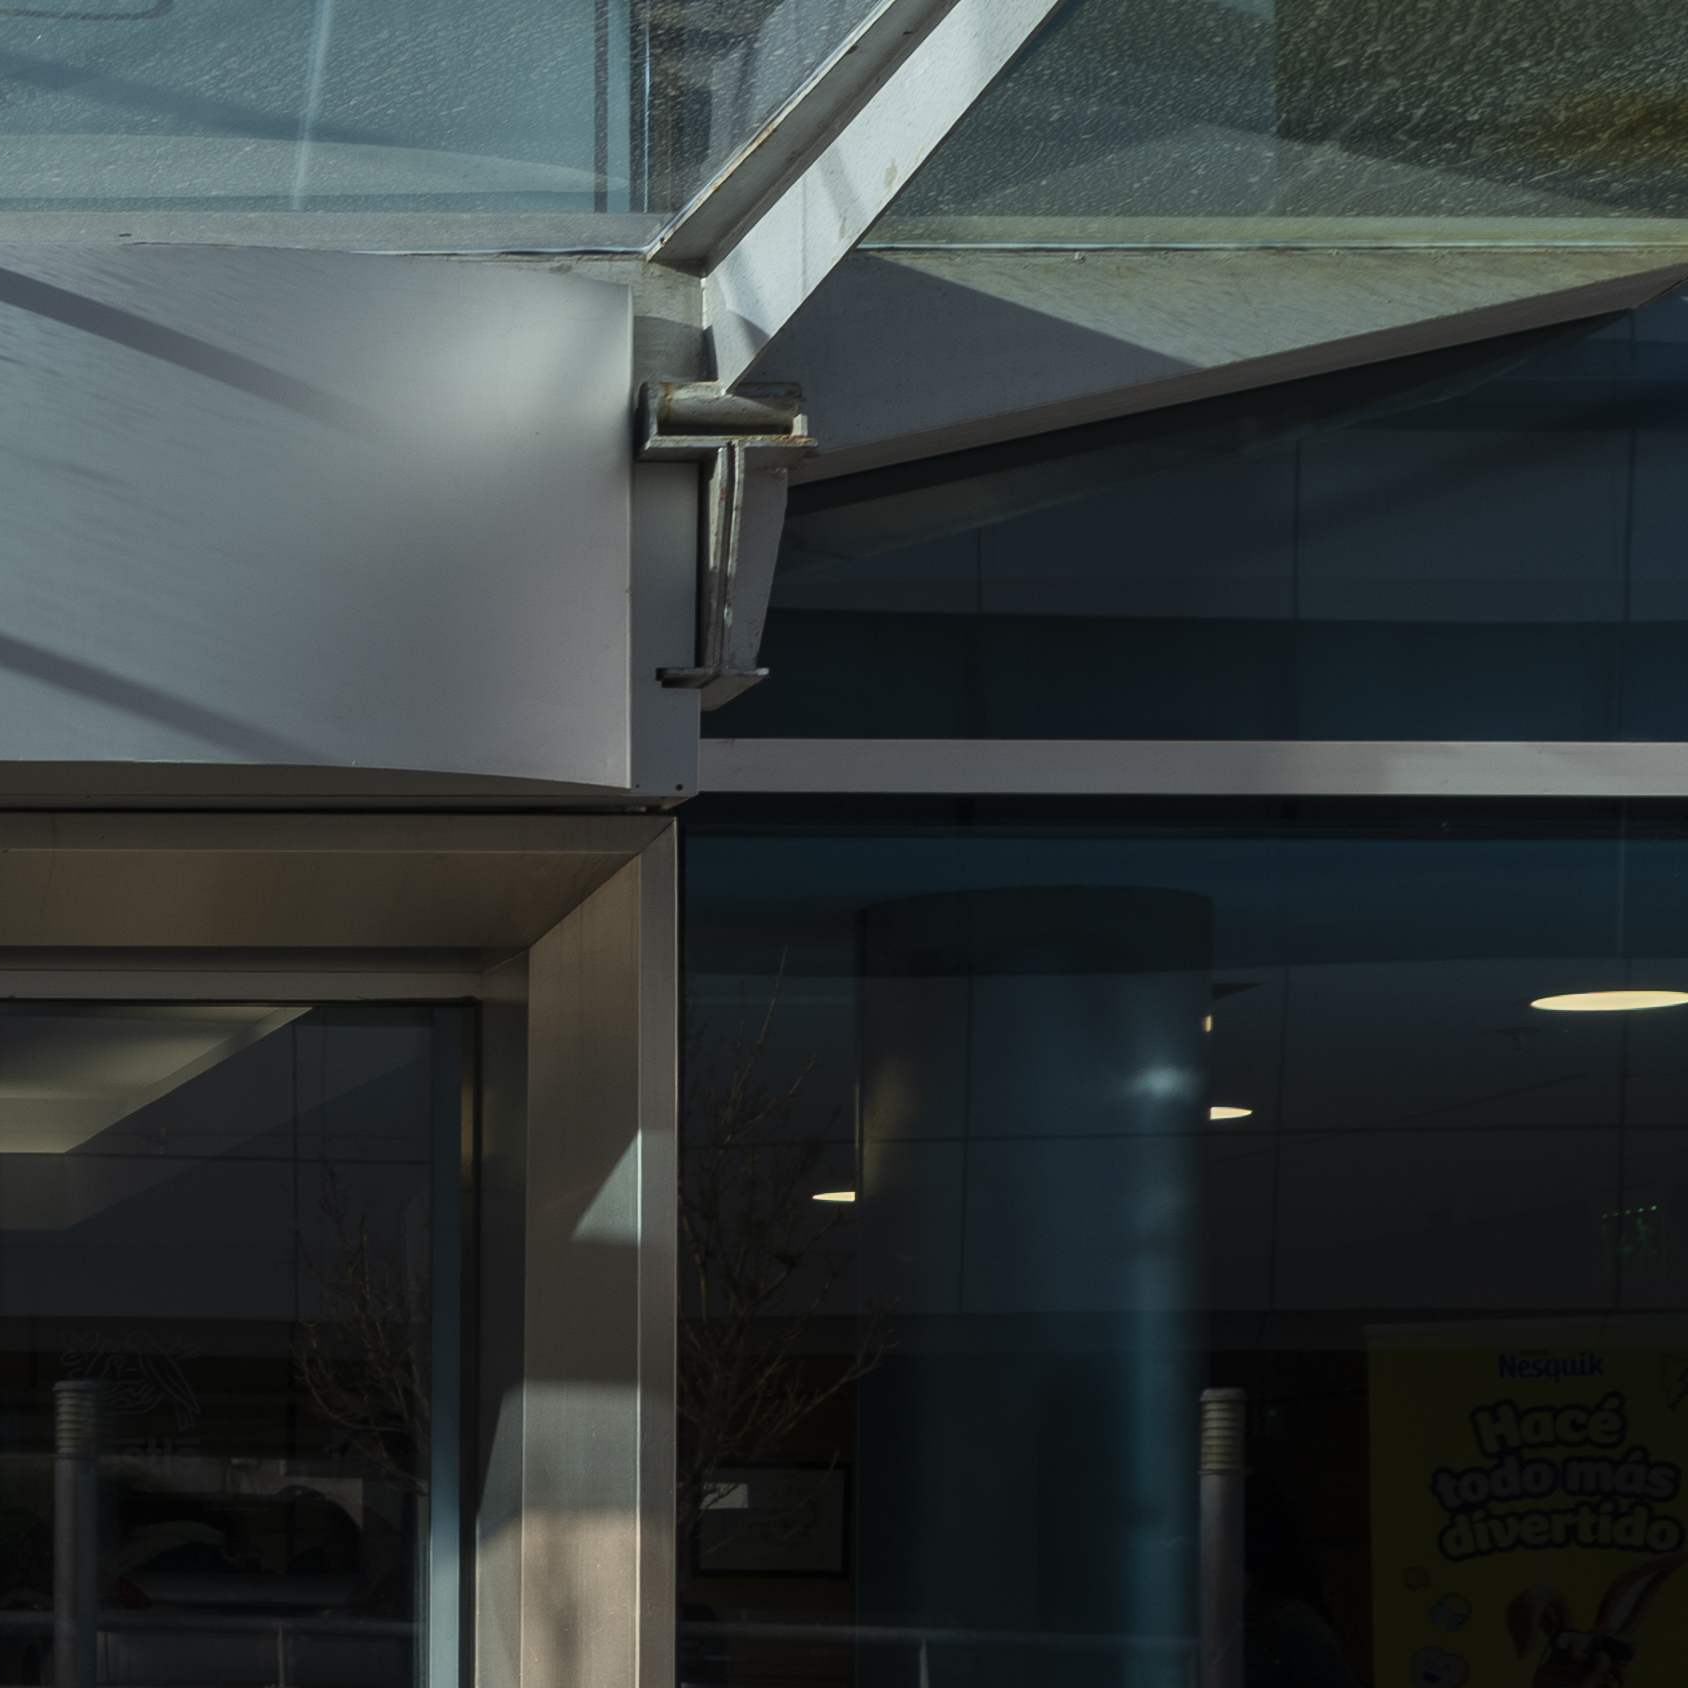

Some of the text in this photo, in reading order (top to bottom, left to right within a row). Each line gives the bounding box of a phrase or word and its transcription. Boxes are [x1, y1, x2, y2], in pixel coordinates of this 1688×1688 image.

[1497, 1352, 1605, 1383] Nesquik
[1472, 1393, 1625, 1456] Hacé
[1433, 1446, 1680, 1510] todo más
[1439, 1499, 1684, 1560] divertido
